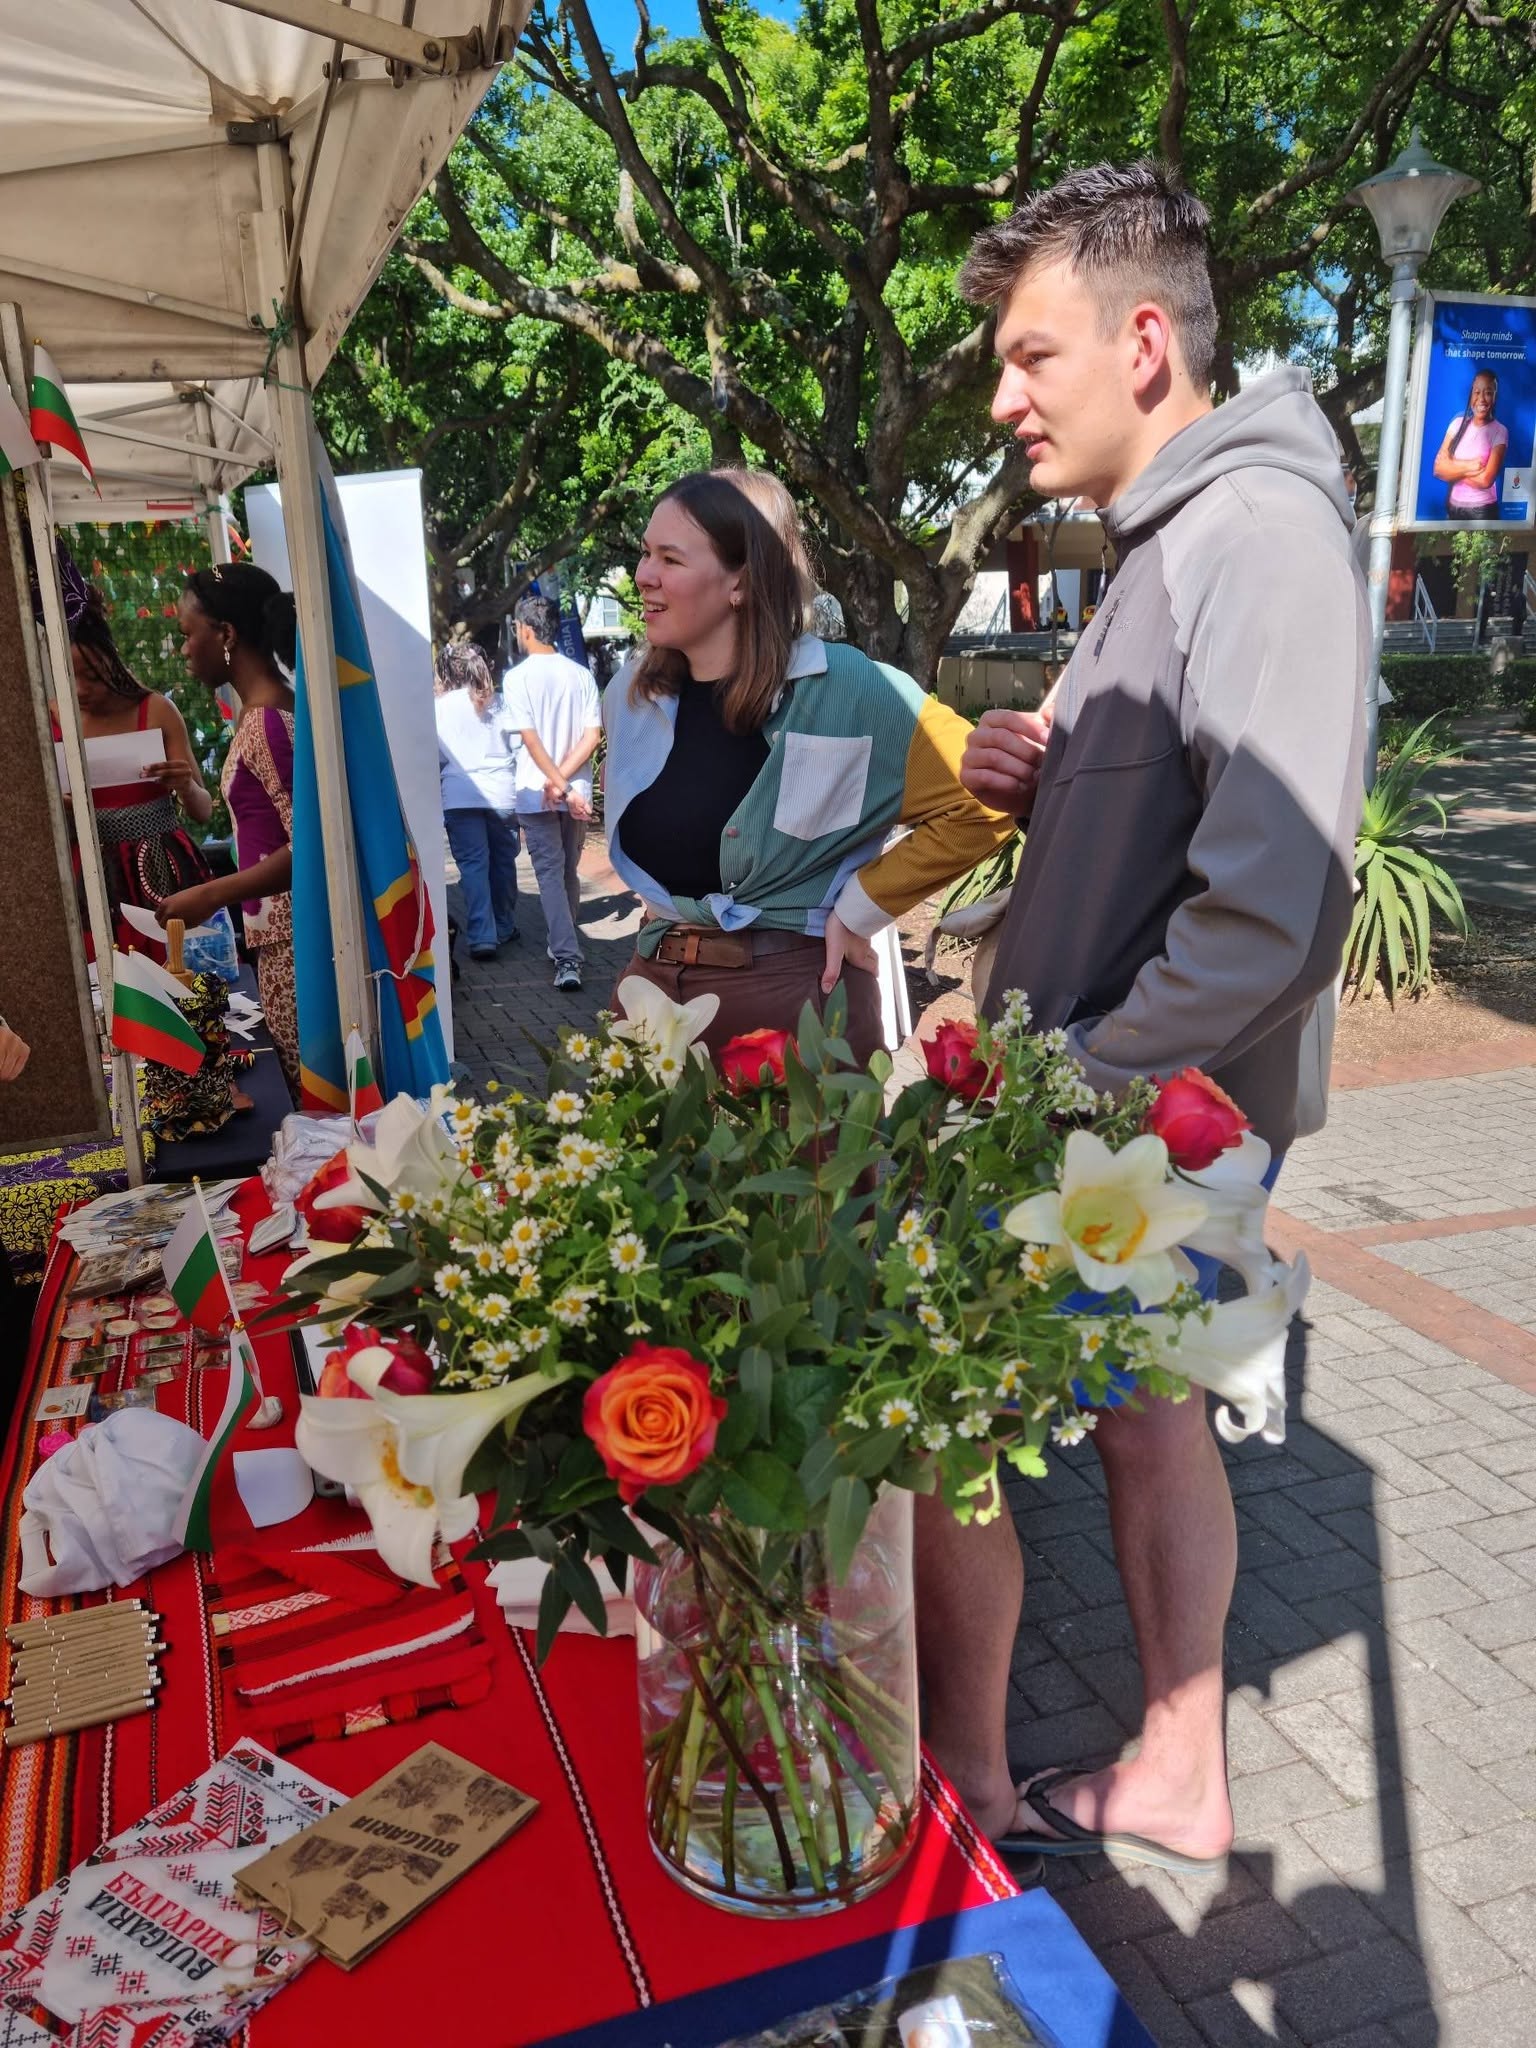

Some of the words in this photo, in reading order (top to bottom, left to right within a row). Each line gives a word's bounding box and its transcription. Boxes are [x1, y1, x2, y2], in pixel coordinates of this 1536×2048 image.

[1461, 329, 1491, 342] Shaping
[1491, 330, 1513, 341] minds
[1445, 347, 1461, 358] that
[1463, 347, 1486, 360] shape
[1487, 349, 1526, 360] tomorrow.
[561, 624, 576, 657] ORIA
[348, 1815, 461, 1858] BULGARIA
[84, 1888, 219, 1981] BULGARIA
